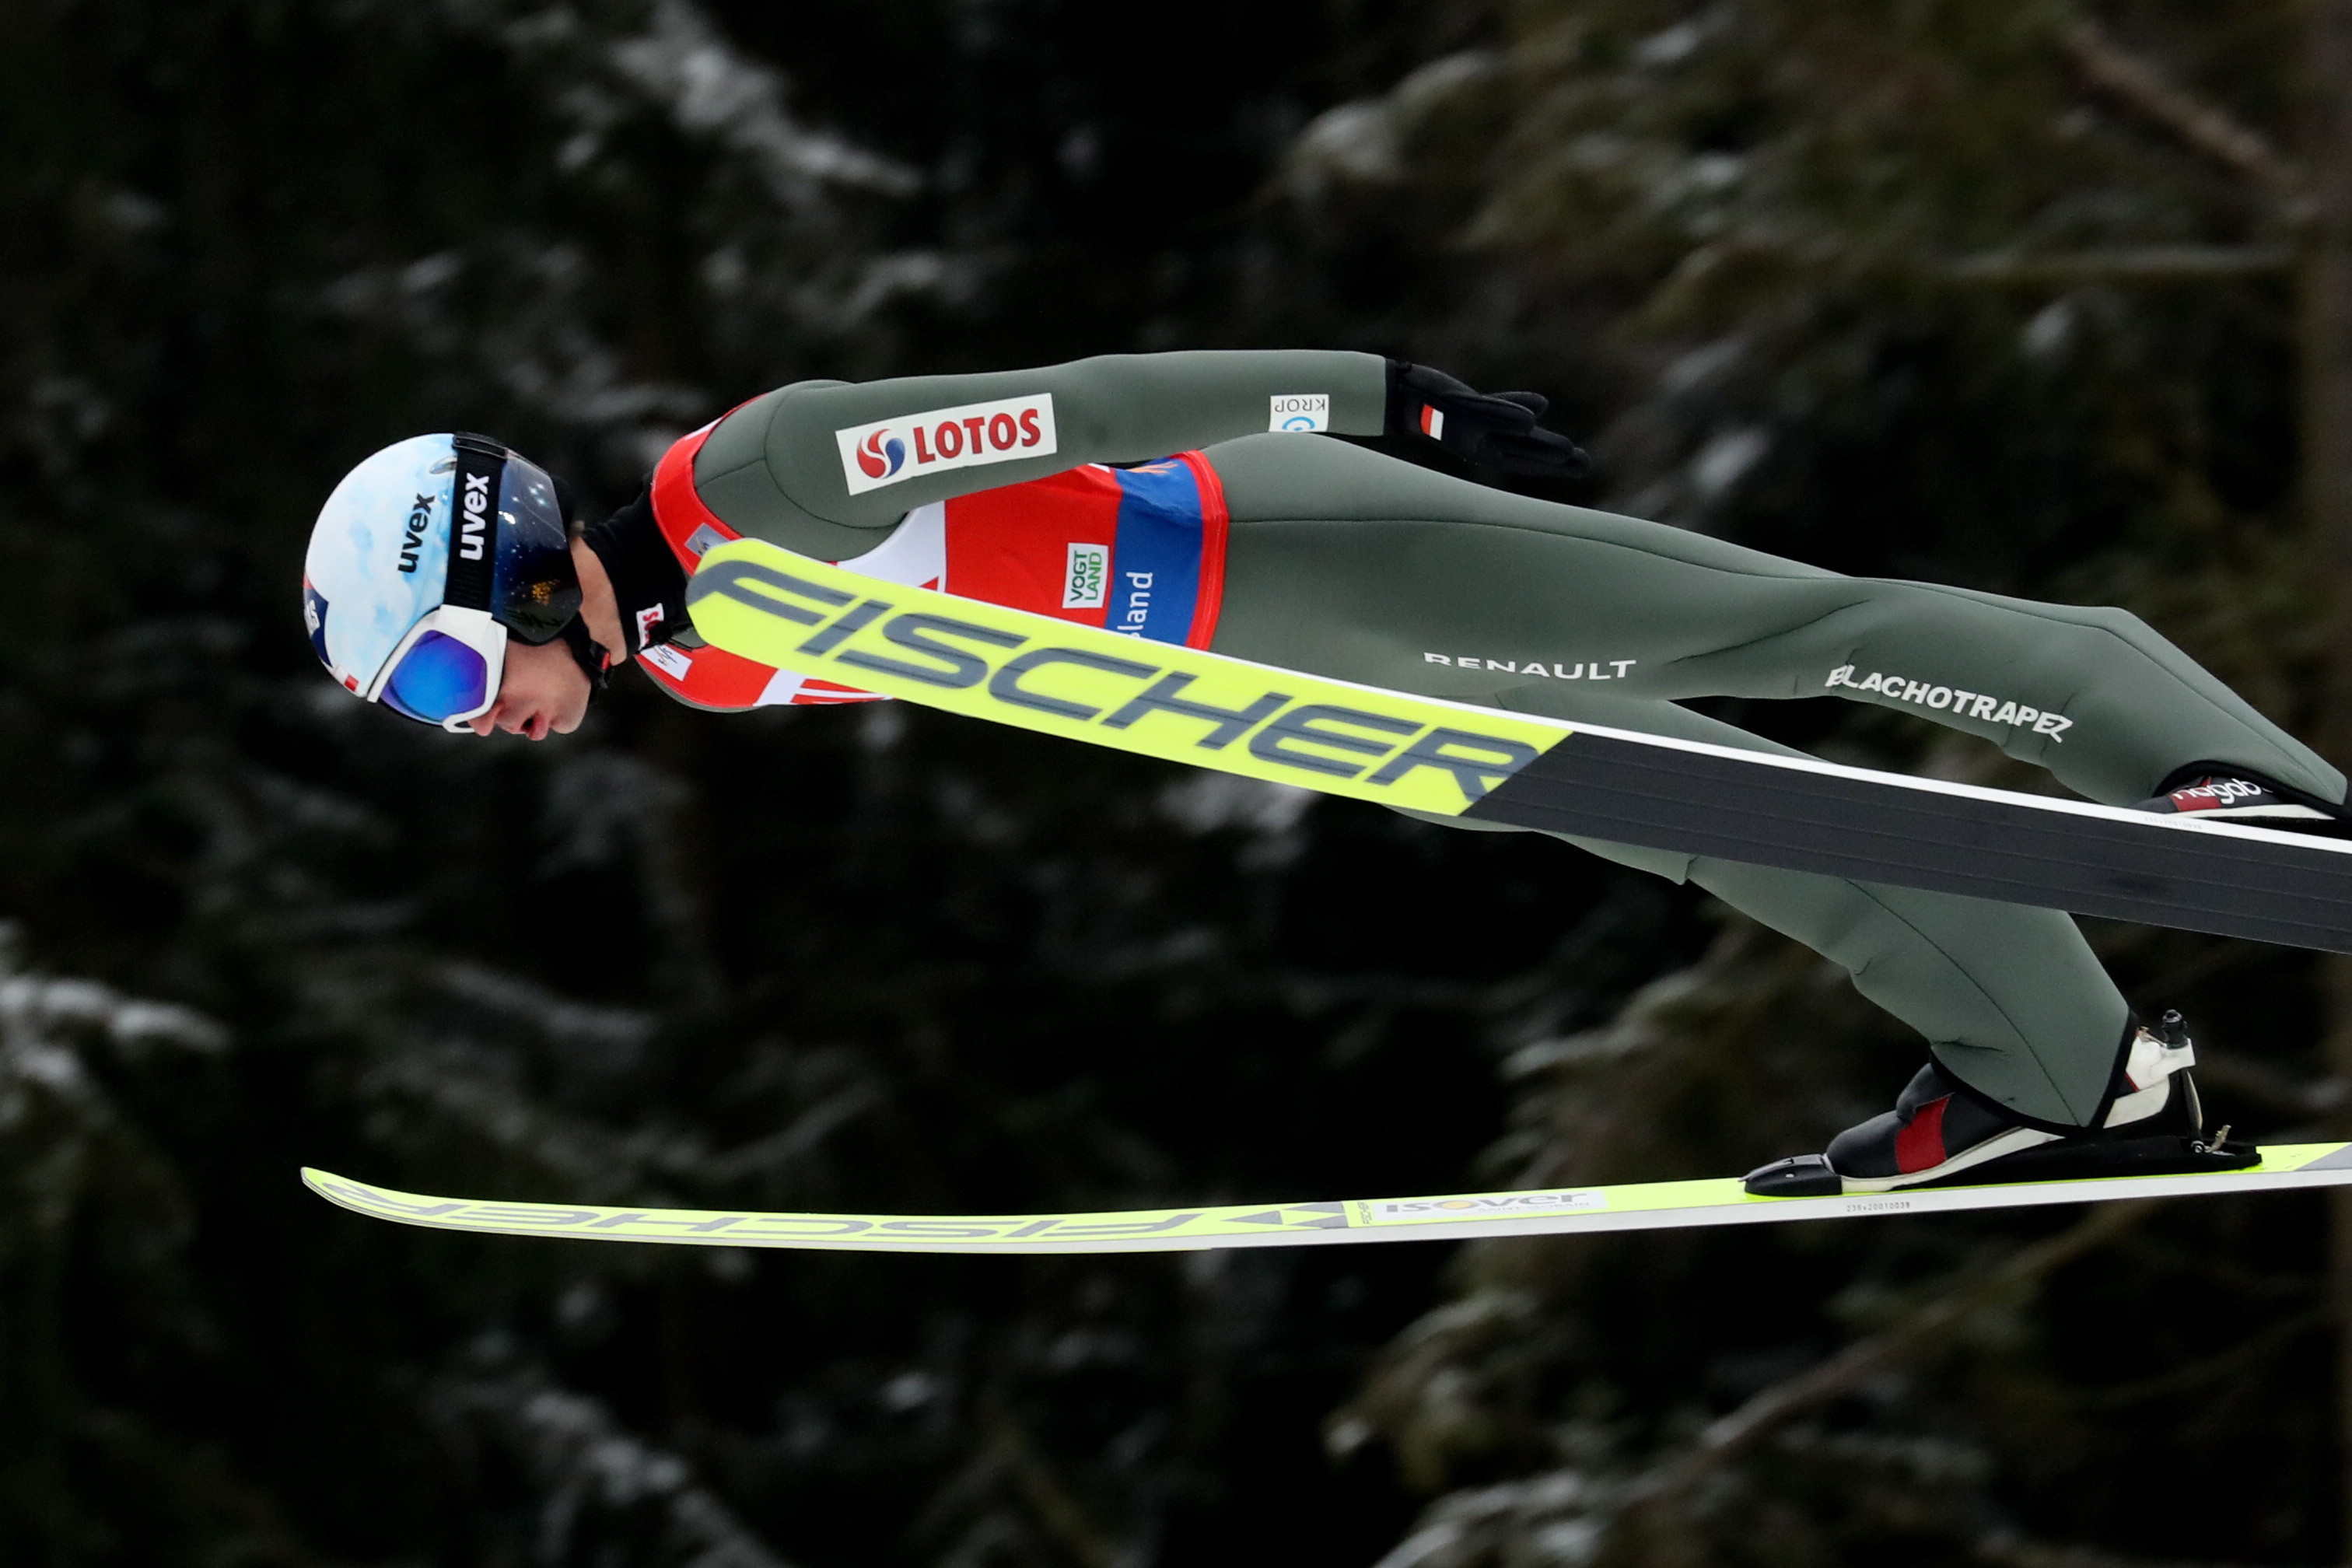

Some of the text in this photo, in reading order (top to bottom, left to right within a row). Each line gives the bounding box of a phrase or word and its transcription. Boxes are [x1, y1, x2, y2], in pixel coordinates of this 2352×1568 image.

[1274, 398, 1326, 413] KROP
[913, 408, 1042, 465] LOTOS
[397, 492, 436, 574] uvex
[460, 472, 490, 562] uvex
[1069, 550, 1087, 602] VOGT
[1084, 551, 1102, 601] LAND
[686, 558, 1539, 803] FISCHER
[1423, 651, 1637, 680] RENAULT
[1824, 663, 2074, 744] BLACHOTRAPEZ
